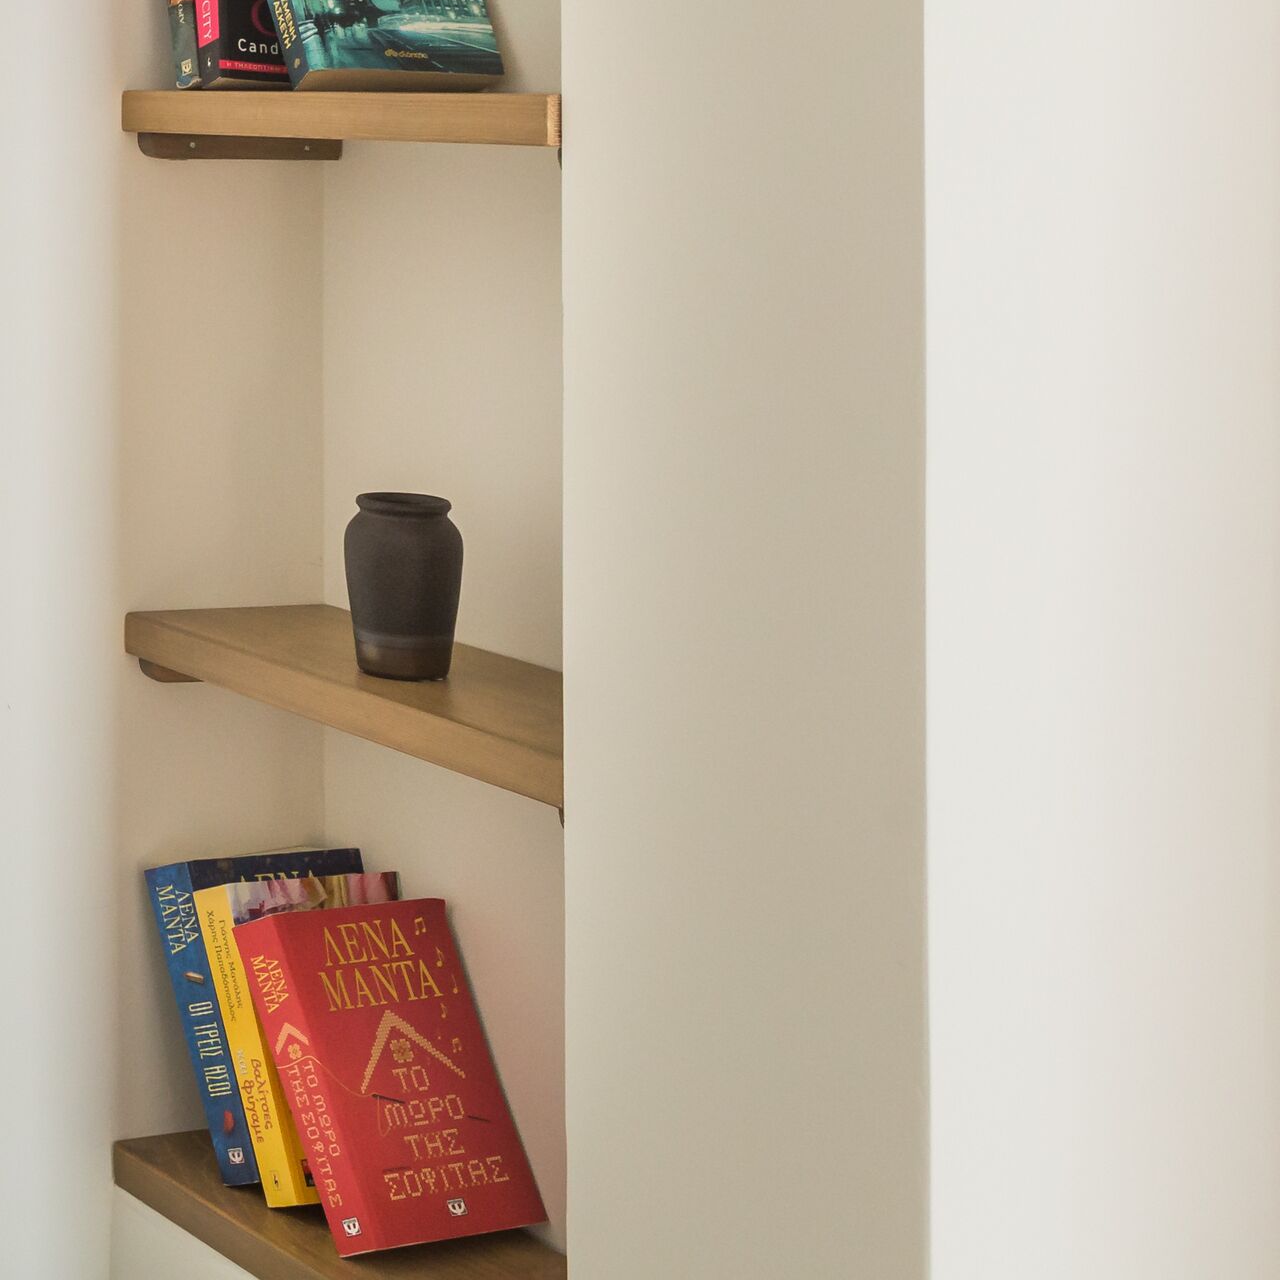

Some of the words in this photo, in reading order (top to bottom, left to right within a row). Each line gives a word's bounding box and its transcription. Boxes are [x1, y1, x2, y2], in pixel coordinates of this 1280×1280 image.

[201, 0, 213, 39] CITY
[238, 38, 279, 54] Cand
[156, 884, 187, 955] ΜΑΝΤΑ
[175, 890, 199, 943] ΛΕΝΑ
[323, 918, 415, 967] ΛΕΝΑ
[206, 910, 219, 943] Χάρης
[214, 945, 236, 1022] Παπαδόπουλος
[251, 955, 280, 1014] ΜΑΝΤΑ
[266, 959, 289, 1003] ΛΕΝΑ
[318, 959, 444, 1012] ΜΑΝΤΑ
[188, 1001, 214, 1017] ΟΙ
[194, 1022, 223, 1059] ΤΡΕΙΣ
[204, 1064, 232, 1097] ΑΣΟΙ
[303, 1060, 319, 1088] ΤΟ
[392, 1065, 430, 1093] ΤΟ
[288, 1066, 310, 1109] ΤΗΣ
[301, 1112, 342, 1208] ΣΟΦΙΤΑΣ
[403, 1128, 466, 1161] ΤΗΣ
[384, 1155, 510, 1201] ΣΟΦΙΤΑΣ
